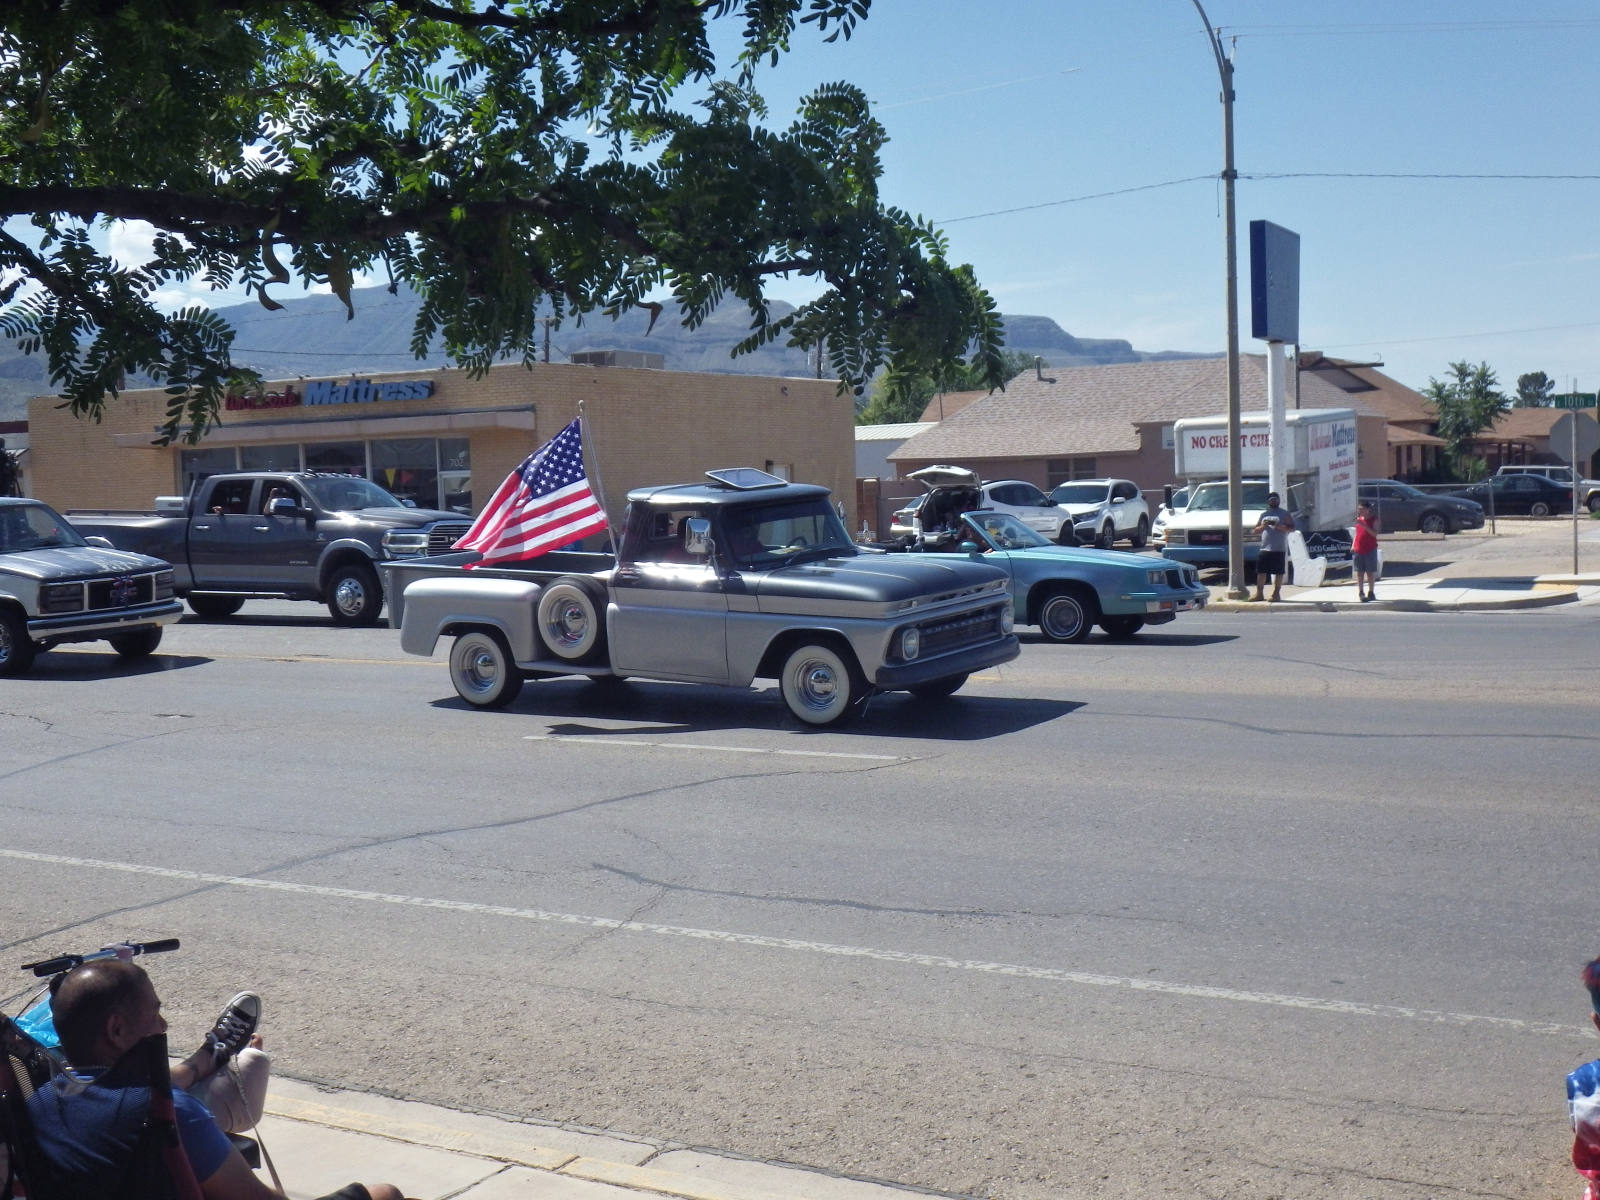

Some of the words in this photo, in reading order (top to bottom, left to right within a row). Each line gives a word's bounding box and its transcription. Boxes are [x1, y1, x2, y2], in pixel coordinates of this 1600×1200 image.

[304, 378, 434, 407] Mattress
[1191, 436, 1207, 449] NO
[1209, 435, 1248, 449] CRET
